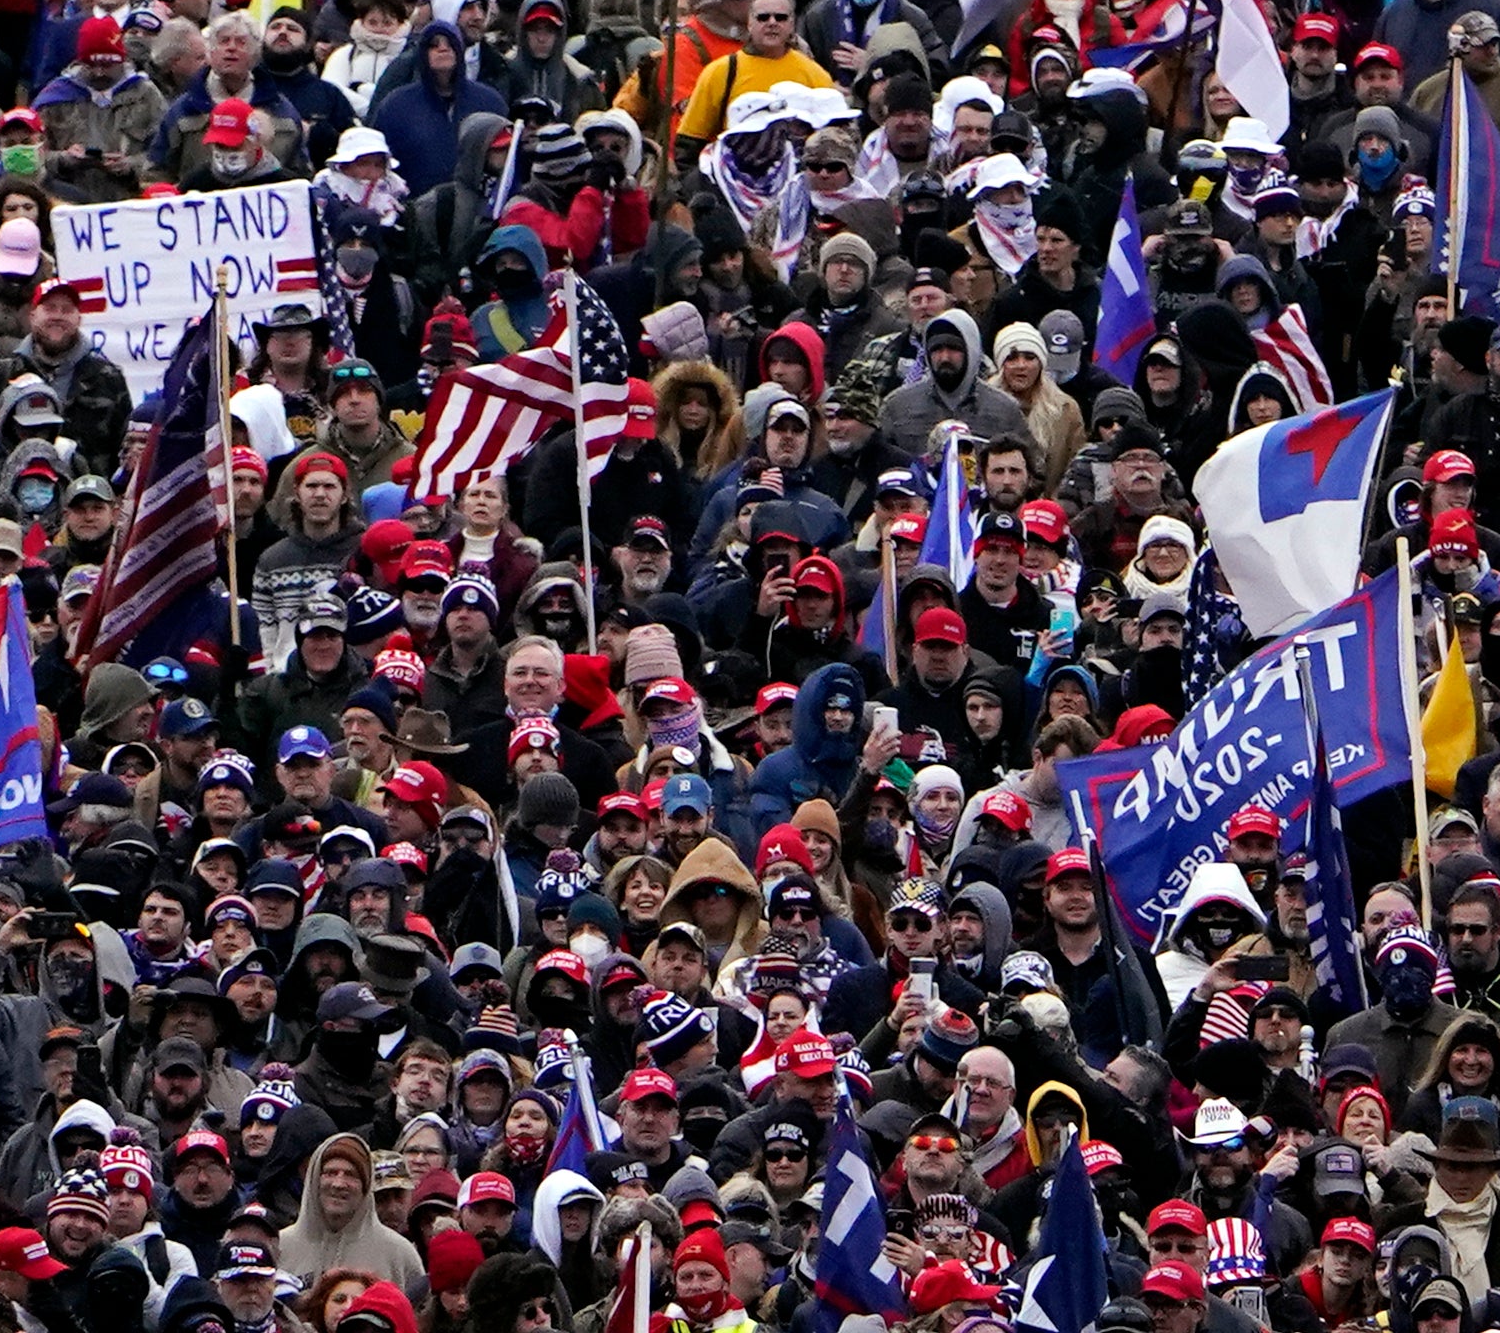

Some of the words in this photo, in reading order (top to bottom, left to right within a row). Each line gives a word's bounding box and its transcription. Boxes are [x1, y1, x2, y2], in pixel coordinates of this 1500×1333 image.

[71, 215, 113, 250] WE
[157, 192, 290, 249] STAND
[108, 266, 150, 306] UP
[214, 254, 276, 299] NOW
